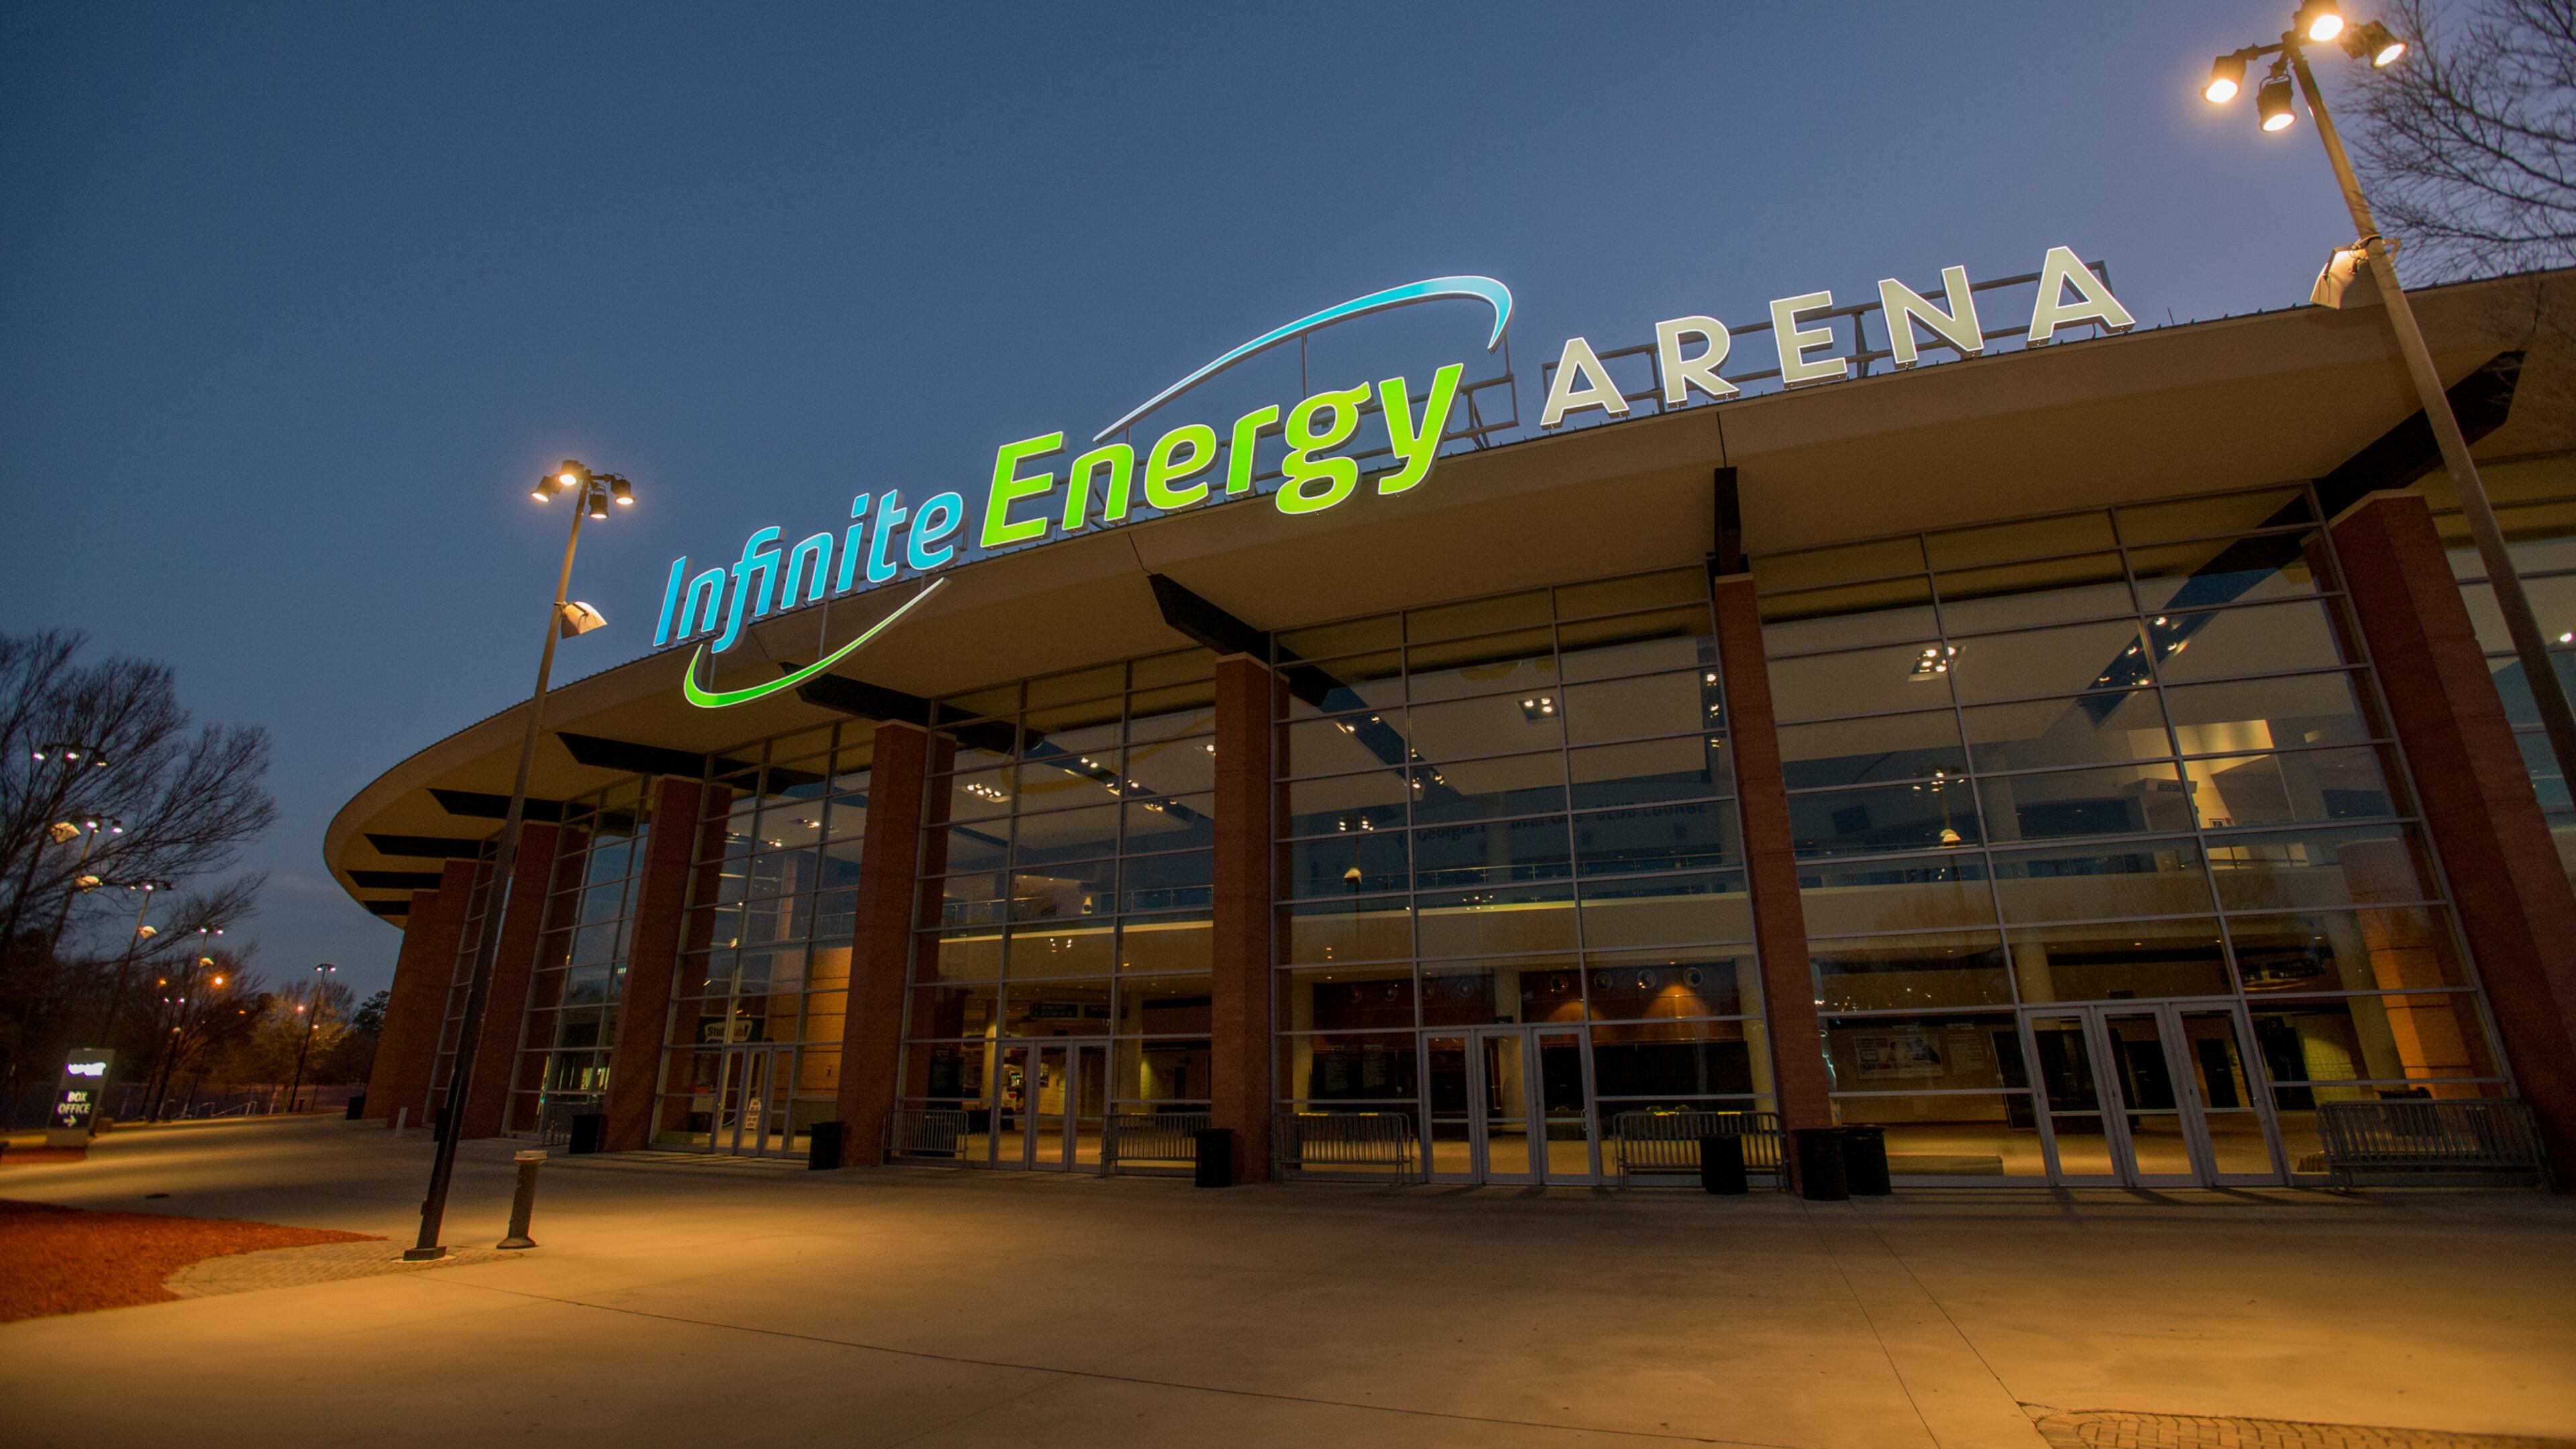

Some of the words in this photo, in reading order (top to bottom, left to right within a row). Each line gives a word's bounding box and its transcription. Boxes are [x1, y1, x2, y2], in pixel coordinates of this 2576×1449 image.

[653, 491, 964, 654] Infinite
[979, 362, 1464, 549] Energy
[1540, 246, 2136, 429] ARENA
[68, 1091, 88, 1102] BOX
[58, 1103, 92, 1114] OFFICE
